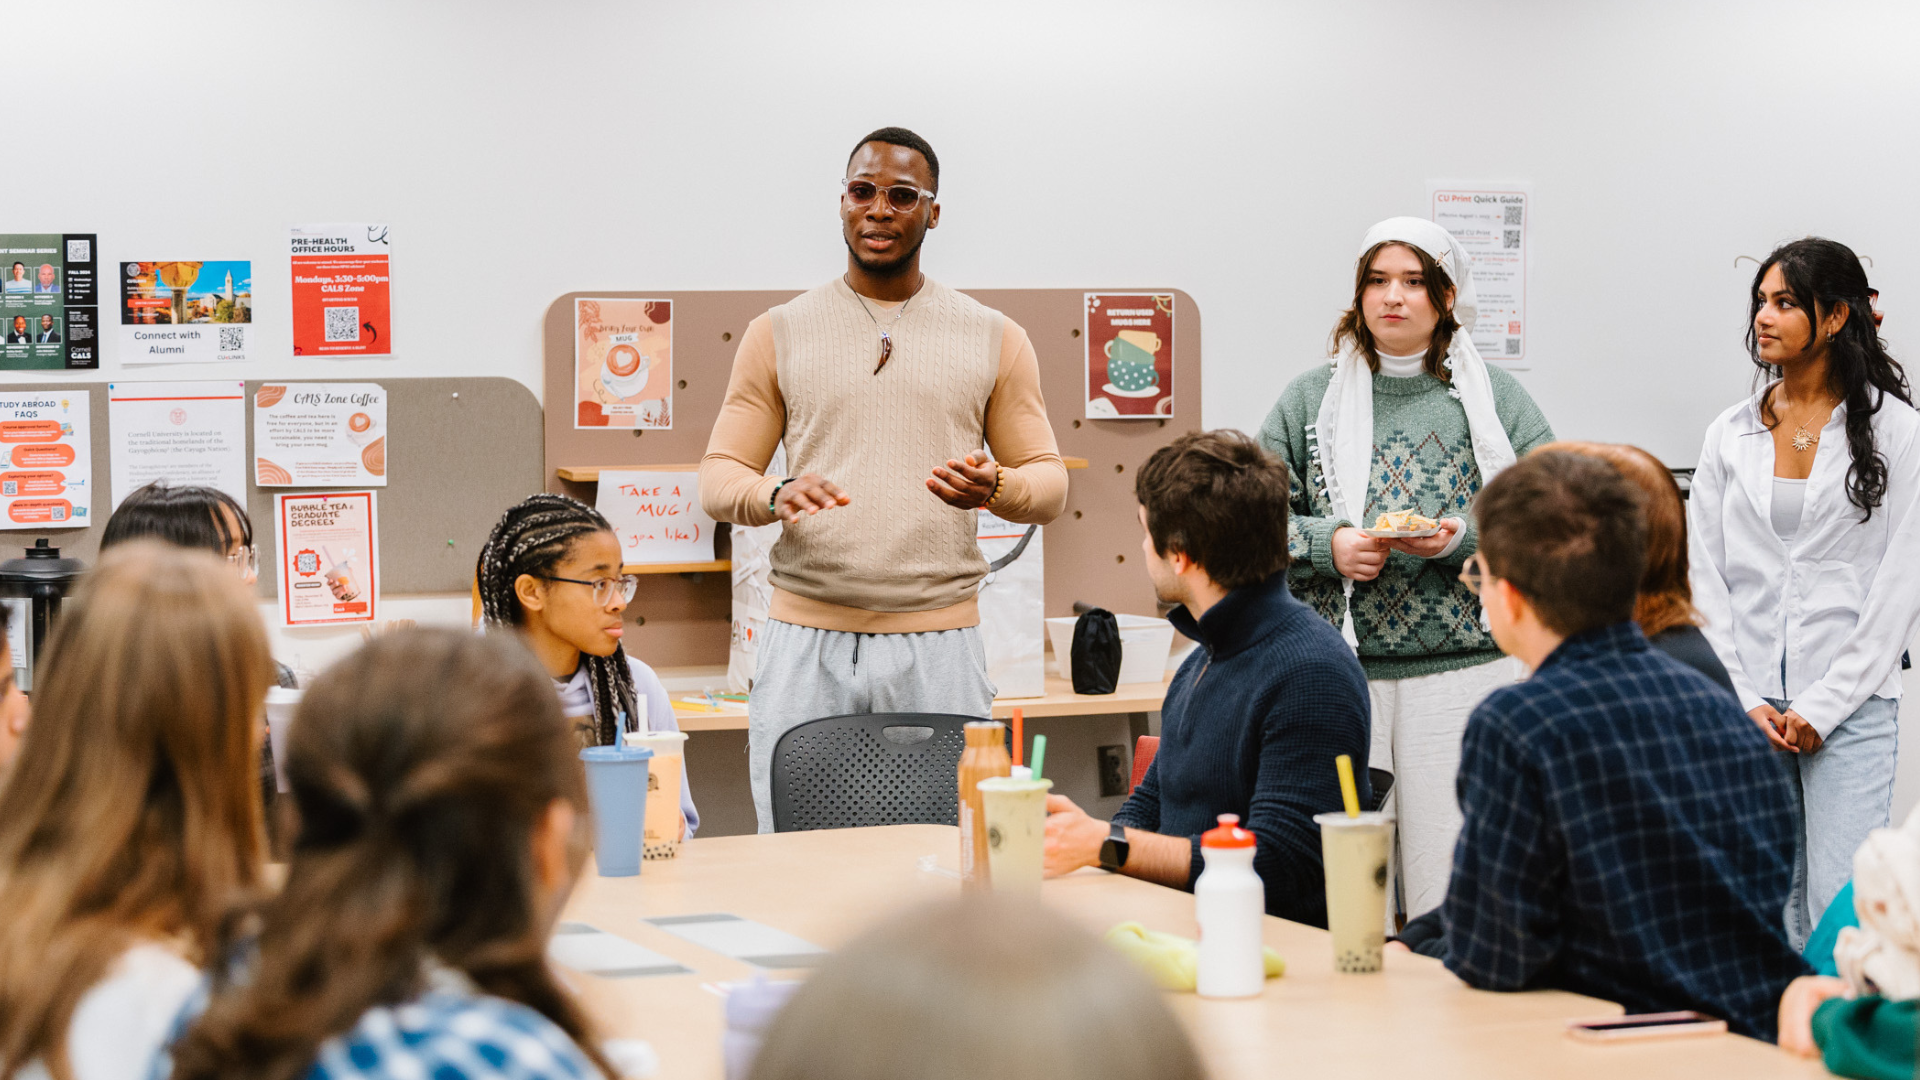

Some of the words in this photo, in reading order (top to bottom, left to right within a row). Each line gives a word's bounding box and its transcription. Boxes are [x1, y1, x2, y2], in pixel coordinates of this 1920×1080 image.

[1474, 195, 1497, 204] Quick
[295, 276, 334, 284] Mondays,
[335, 275, 388, 284] 3:30-5:00pm
[134, 332, 176, 340] Connect
[180, 331, 200, 339] with
[149, 345, 184, 354] Alumni
[324, 393, 348, 404] Zone
[350, 393, 379, 406] Coffee
[618, 484, 661, 496] TAKE
[671, 486, 680, 497] A
[628, 534, 654, 548] you
[665, 523, 699, 543] like)
